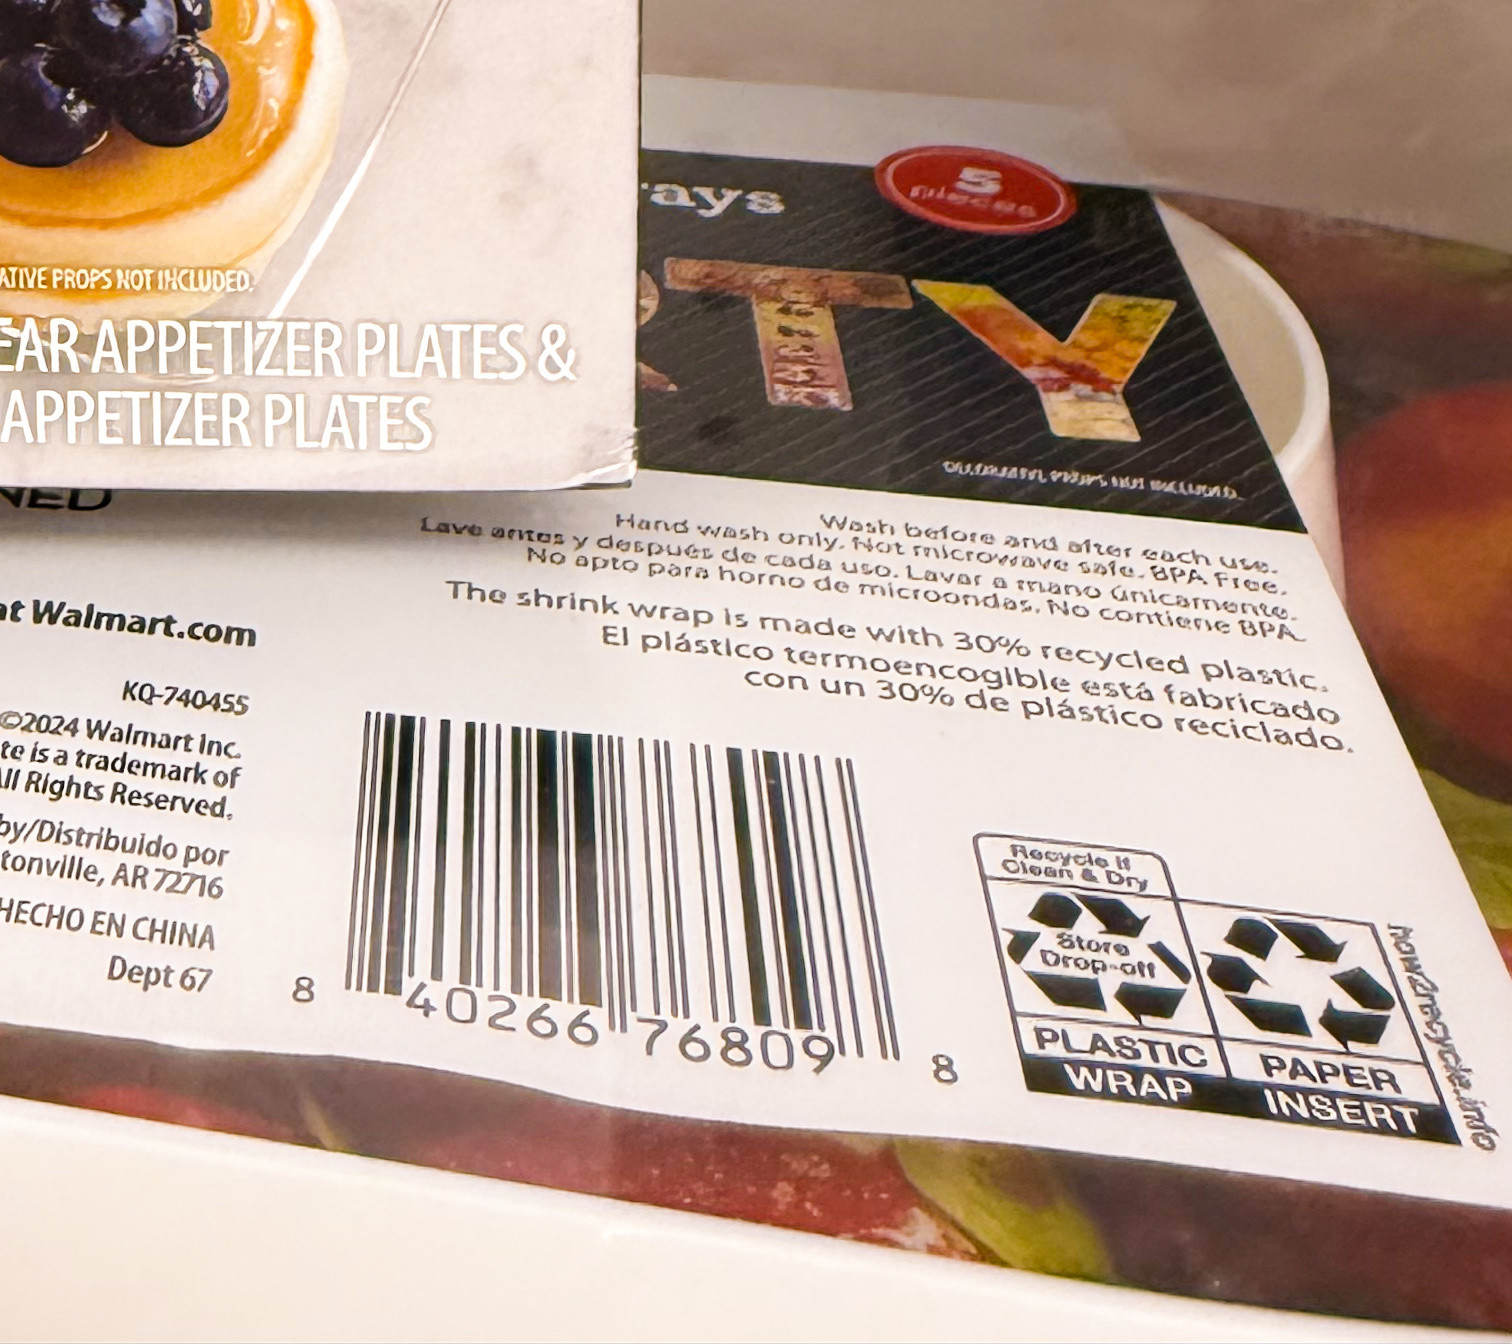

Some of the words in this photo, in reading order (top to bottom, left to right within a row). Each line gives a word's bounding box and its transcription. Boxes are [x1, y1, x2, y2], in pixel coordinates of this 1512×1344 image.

[641, 181, 787, 215] ays
[52, 268, 112, 290] PROPS
[116, 269, 154, 290] NOT
[157, 269, 254, 293] INCLUDED.
[91, 319, 344, 378] APPETIZER
[357, 323, 527, 380] PLATES
[538, 323, 578, 381] &
[0, 389, 251, 447] APPETIZER
[264, 392, 433, 451] PLATES
[420, 515, 482, 538] Lave
[490, 526, 566, 546] antes
[573, 534, 589, 551] y
[720, 546, 757, 565] de
[763, 551, 833, 572] cada
[841, 559, 899, 579] uso.
[906, 565, 982, 588] Lavar
[1016, 579, 1100, 598] mano
[615, 513, 690, 535] Hand
[696, 523, 769, 543] wash
[777, 531, 846, 555] only.
[853, 535, 905, 557] Not
[912, 543, 1070, 573] microwave
[1215, 572, 1288, 597] Free.
[819, 513, 895, 536] Wash
[904, 523, 996, 546] before
[1003, 530, 1059, 553] and
[1067, 537, 1133, 559] after
[1142, 544, 1210, 567] each
[1219, 554, 1279, 576] use.
[526, 547, 566, 565] No
[575, 553, 638, 573] apto
[648, 561, 710, 580] para
[719, 566, 806, 589] horno
[815, 575, 850, 594] de
[858, 581, 1041, 614] microondas.
[1048, 599, 1090, 617] No
[1099, 607, 1230, 635] contiene
[32, 599, 256, 647] Walmart.com
[445, 580, 507, 604] The
[516, 588, 620, 615] shrink
[628, 600, 714, 630] wrap
[724, 608, 748, 627] is
[758, 615, 857, 640] made
[866, 624, 943, 649] with
[953, 631, 1031, 659] 30%
[1041, 643, 1190, 675] recycled
[1201, 658, 1330, 696] plastic.
[601, 625, 630, 647] El
[641, 628, 774, 663] plástico
[784, 646, 1071, 694] termoencogible
[1081, 679, 1155, 703] está
[1164, 683, 1341, 727] fabricado
[86, 719, 194, 753] Walmart
[199, 735, 241, 760] Inc.
[744, 669, 809, 692] con
[820, 677, 866, 698] un
[877, 679, 955, 708] 30%
[965, 690, 1010, 713] de
[1021, 698, 1164, 731] plástico
[1174, 715, 1355, 754] reciclado.
[29, 742, 50, 764] is
[53, 748, 69, 766] a
[75, 749, 208, 786] trademark
[213, 766, 243, 790] of
[25, 771, 105, 804] Rights
[109, 787, 234, 821] Reserved.
[110, 863, 149, 891] AR
[153, 868, 224, 900] 72716
[182, 843, 230, 870] por
[1105, 869, 1148, 892] Dry
[90, 912, 126, 939] EN
[131, 917, 215, 952] CHINA
[1056, 932, 1130, 956] Store
[106, 955, 174, 993] Dept
[178, 966, 214, 994] 67
[292, 976, 315, 1003] 8
[405, 981, 600, 1049] 40266
[636, 1016, 838, 1074] 76809
[932, 1053, 959, 1085] 8
[1034, 1025, 1208, 1070] PLASTIC
[1259, 1053, 1403, 1096] PAPER
[1064, 1063, 1194, 1103] WRAP
[1263, 1088, 1420, 1136] INSERT
